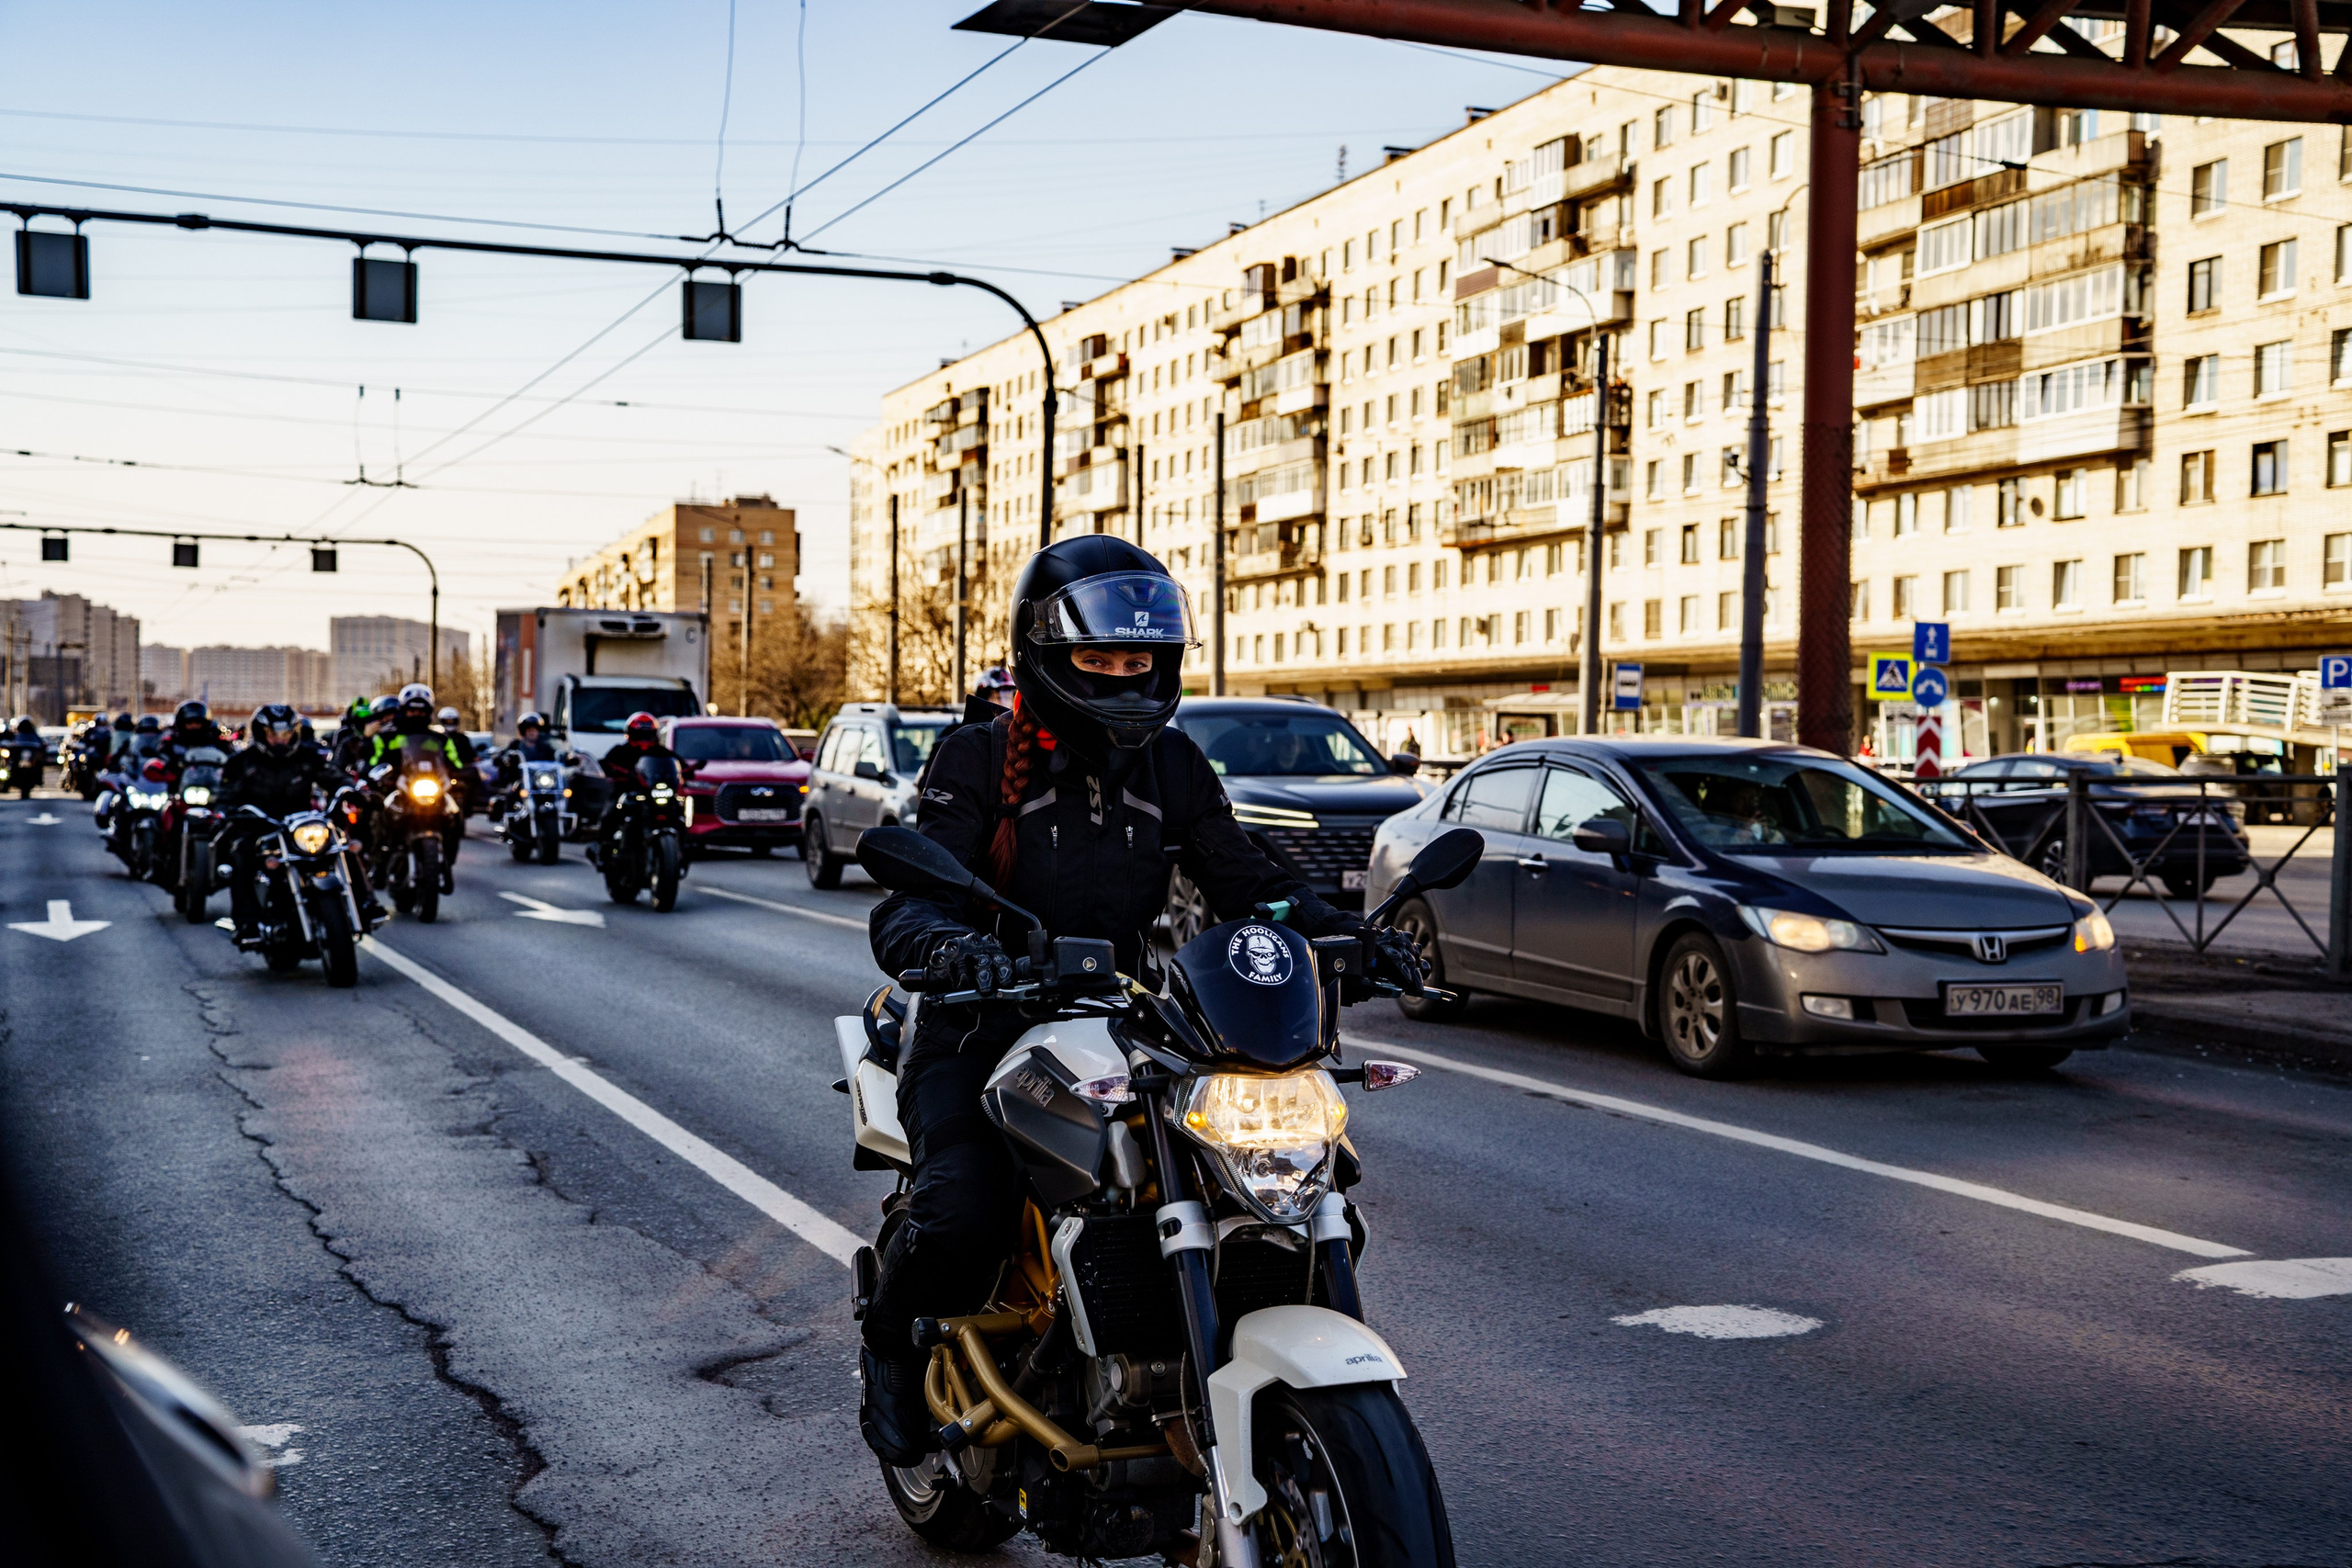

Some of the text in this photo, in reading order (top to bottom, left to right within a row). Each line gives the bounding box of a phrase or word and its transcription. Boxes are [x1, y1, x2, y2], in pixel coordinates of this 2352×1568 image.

[1114, 627, 1164, 637] SHARK
[2328, 659, 2348, 686] P
[1086, 775, 1102, 825] LS2
[1231, 927, 1290, 959] THE HOOLIGANS
[1248, 971, 1283, 983] FAMILY
[1014, 1066, 1055, 1108] aprilia
[1344, 1353, 1384, 1365] aprilia
